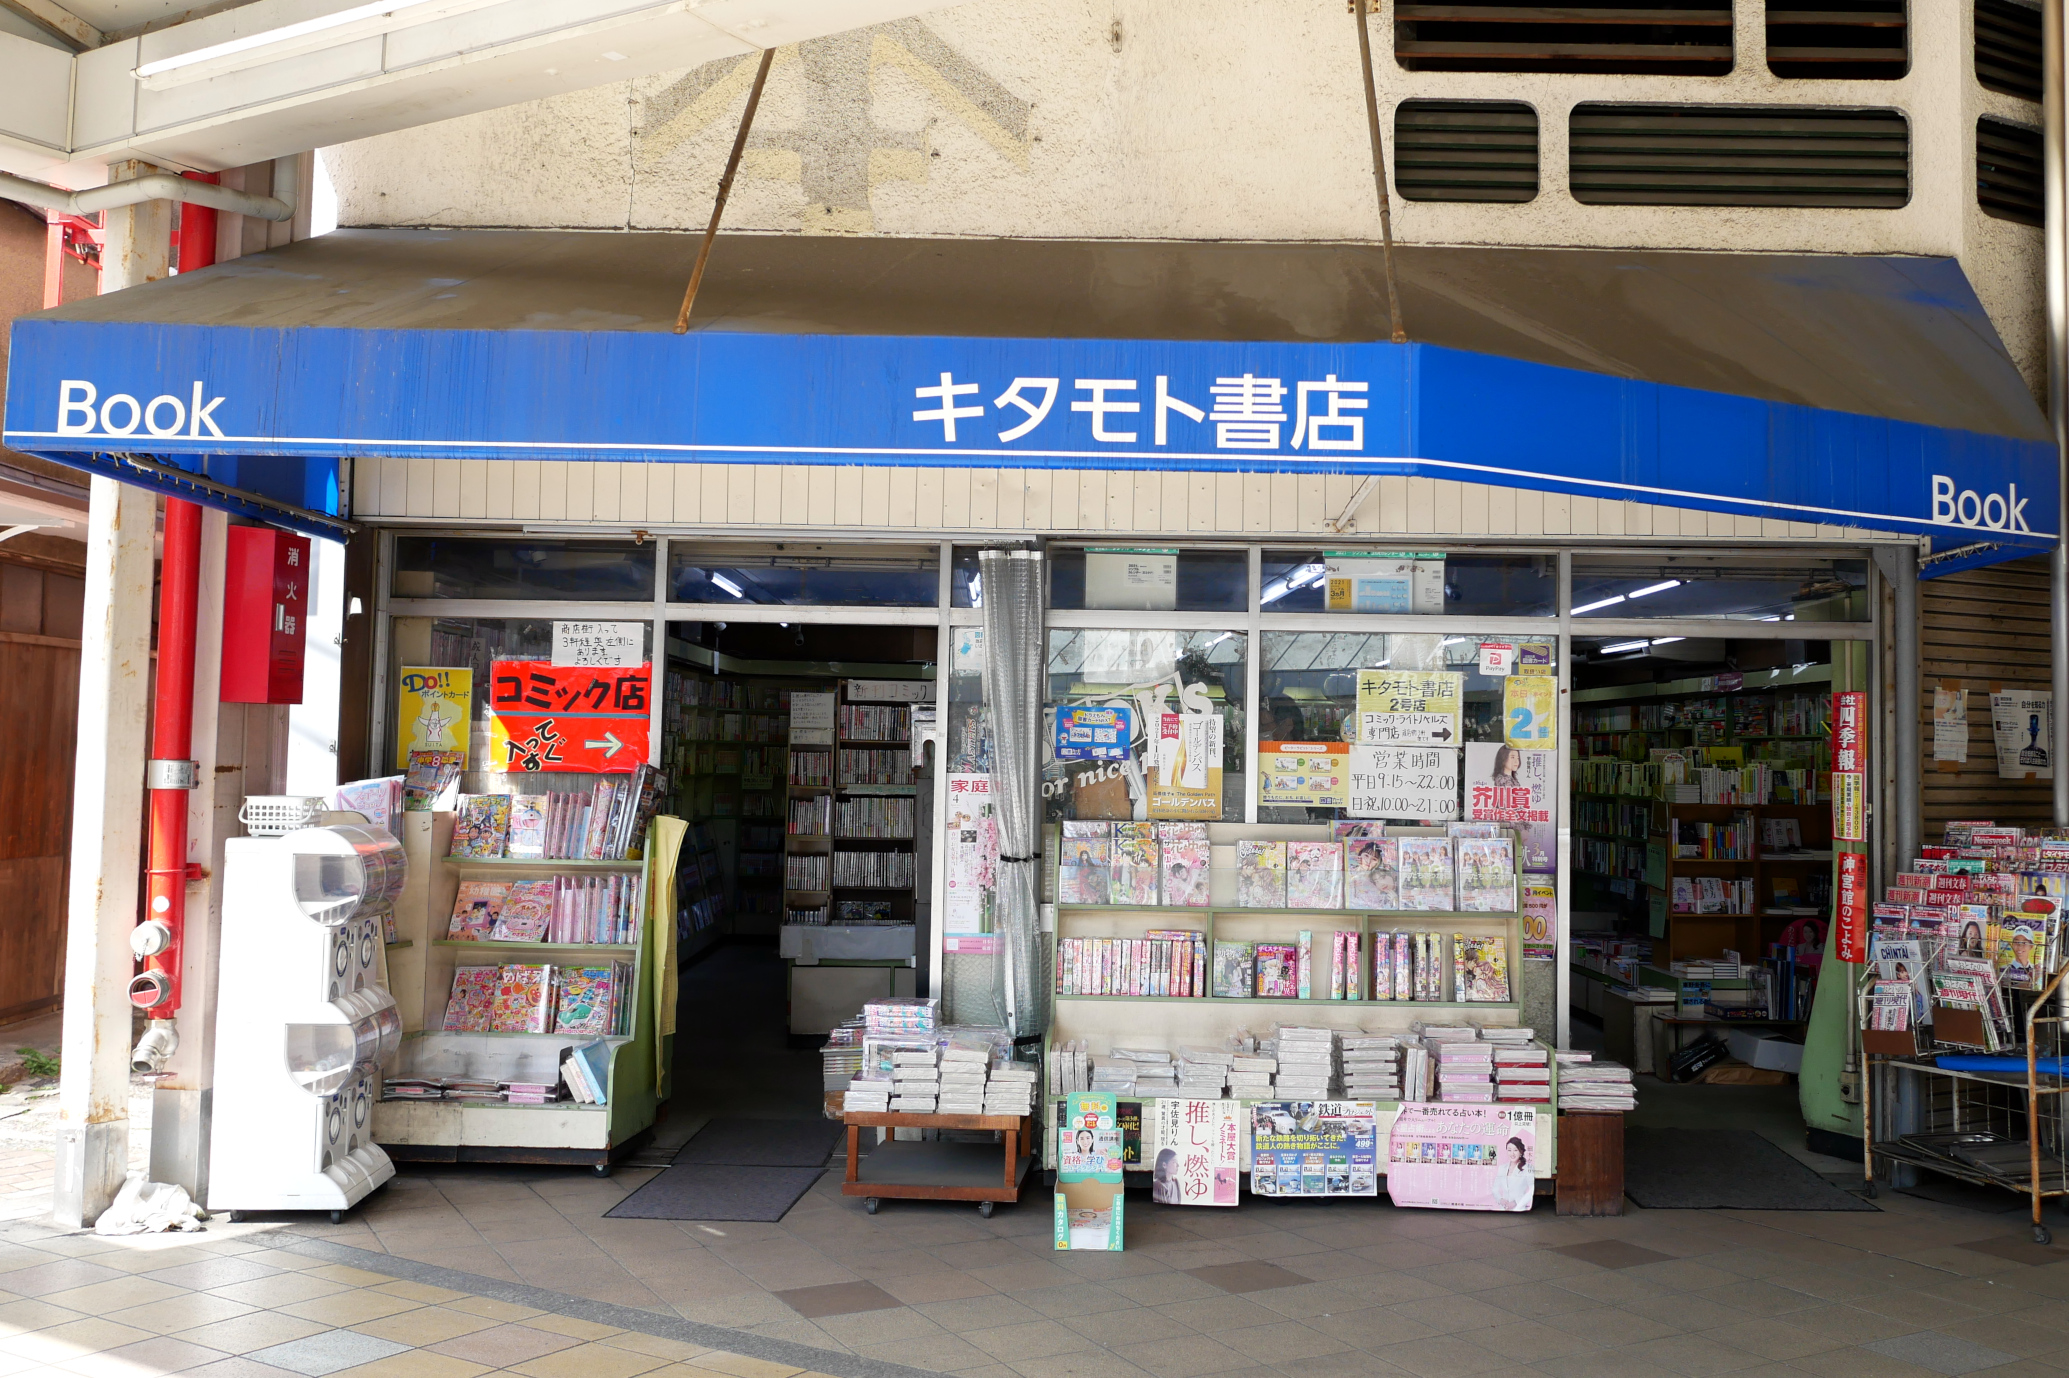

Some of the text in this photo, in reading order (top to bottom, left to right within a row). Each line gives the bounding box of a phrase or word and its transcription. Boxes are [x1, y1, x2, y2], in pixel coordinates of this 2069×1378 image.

[57, 379, 226, 438] Book
[912, 371, 1369, 451] キタモト書店
[1931, 474, 2031, 533] Book
[284, 547, 300, 635] 消火器
[576, 647, 608, 656] あります
[421, 689, 470, 699] ポイントカード
[496, 672, 648, 712] コミック店
[853, 683, 927, 701] 新刊コミック
[1361, 679, 1455, 698] キタモト書店
[1389, 698, 1427, 711] 2号店
[1509, 707, 1533, 739] 2
[1367, 726, 1400, 740] 専門店
[1372, 750, 1440, 770] 営業時間
[1078, 760, 1131, 788] nice
[1152, 797, 1217, 808] ゴールデンパス
[1472, 786, 1531, 809] 芥川賞
[1472, 808, 1549, 822] 受賞作全文掲載
[1973, 835, 2012, 845] Newsweek
[1938, 877, 1967, 890] 週刊文春
[2022, 875, 2062, 893] AERA
[1928, 892, 1961, 904] 週刊文春
[1841, 856, 1856, 960] 神宮館のこよみ
[1080, 1101, 1100, 1111] 無料
[1318, 1102, 1342, 1116] 鉄道
[1170, 1100, 1180, 1146] 宇佐見りん
[1507, 1111, 1534, 1122] 1億冊
[1183, 1100, 1210, 1201] 推し、燃ゆ
[1226, 1123, 1237, 1161] 本屋大賞
[1255, 1142, 1341, 1151] 鉄道人の熱き物語がここに。
[1355, 1140, 1370, 1148] 499
[1063, 1155, 1104, 1165] 資格 学び
